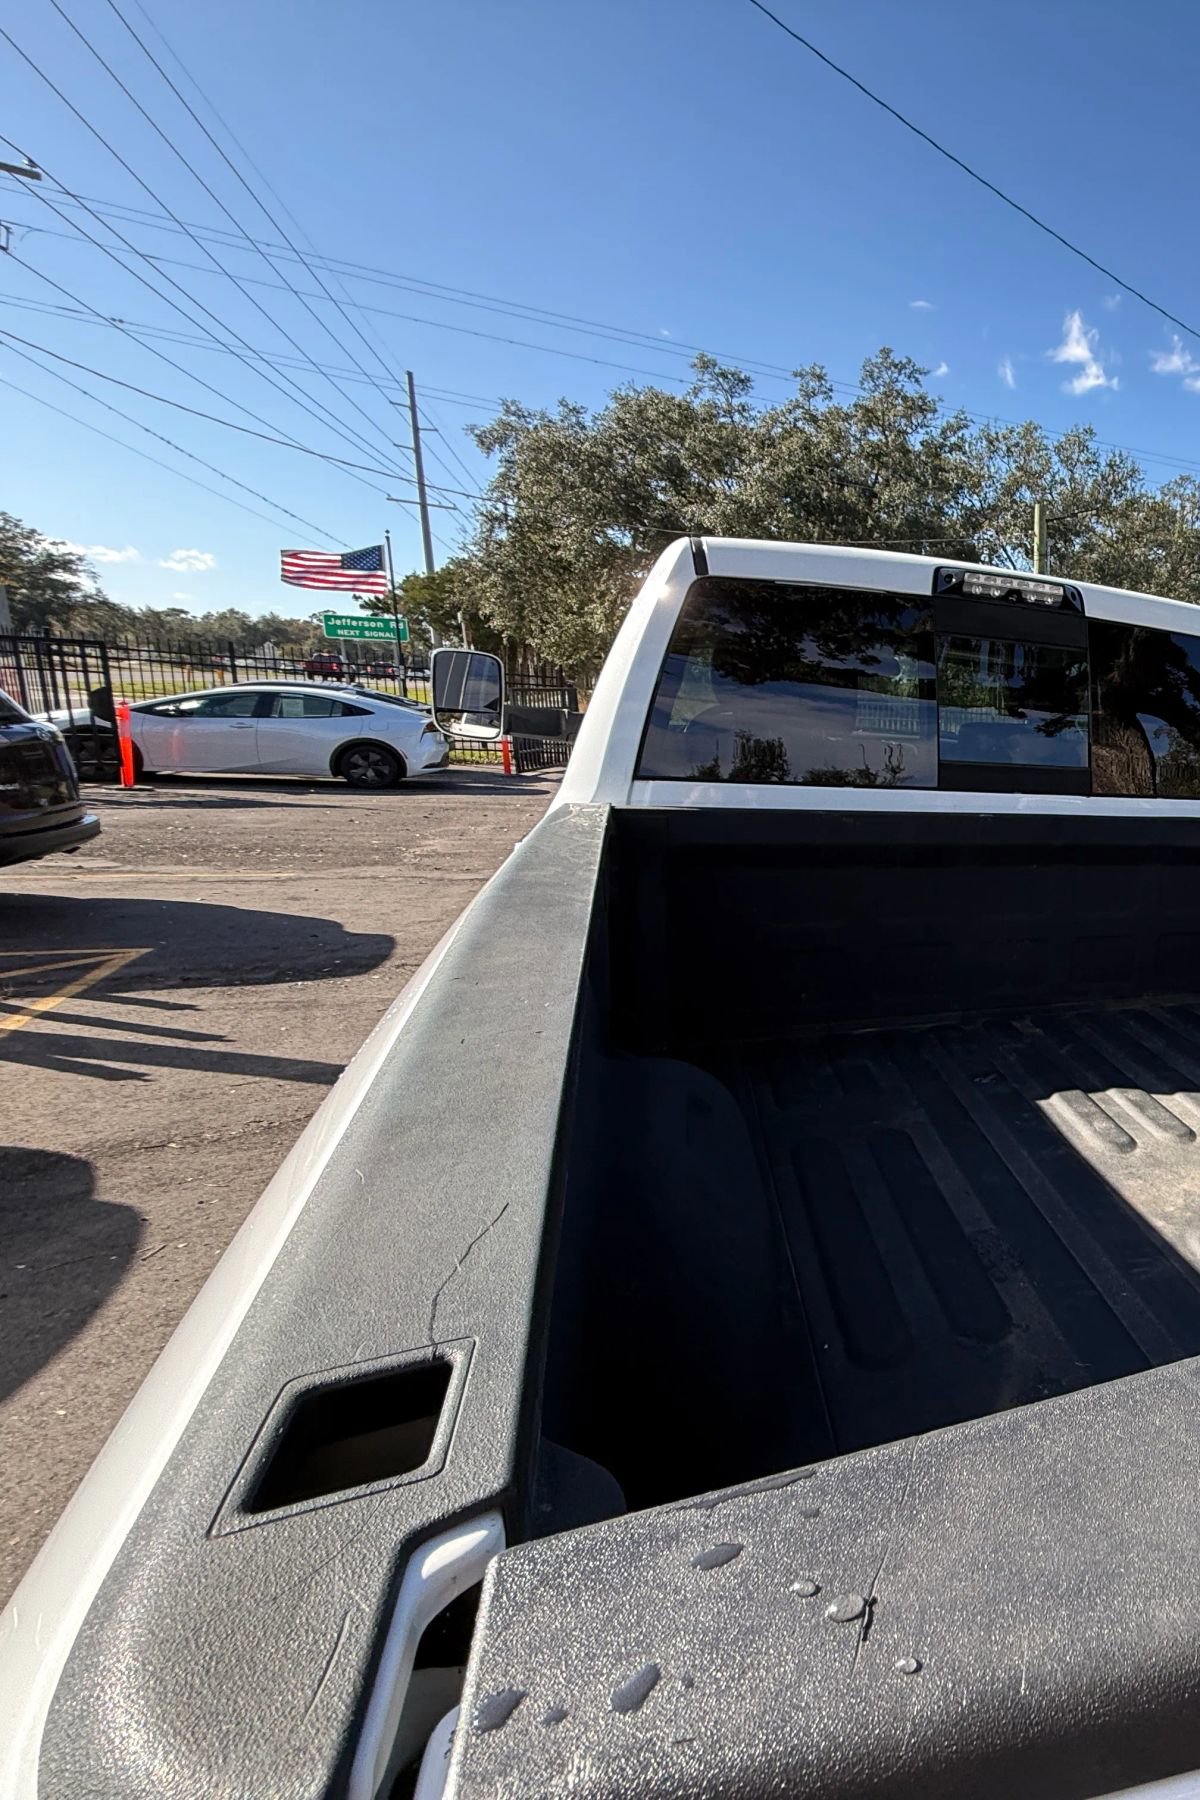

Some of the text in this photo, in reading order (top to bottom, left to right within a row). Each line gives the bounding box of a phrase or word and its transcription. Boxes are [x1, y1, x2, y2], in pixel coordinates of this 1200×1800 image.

[328, 617, 404, 629] Jefferson Rd
[364, 630, 397, 638] SIGNAL
